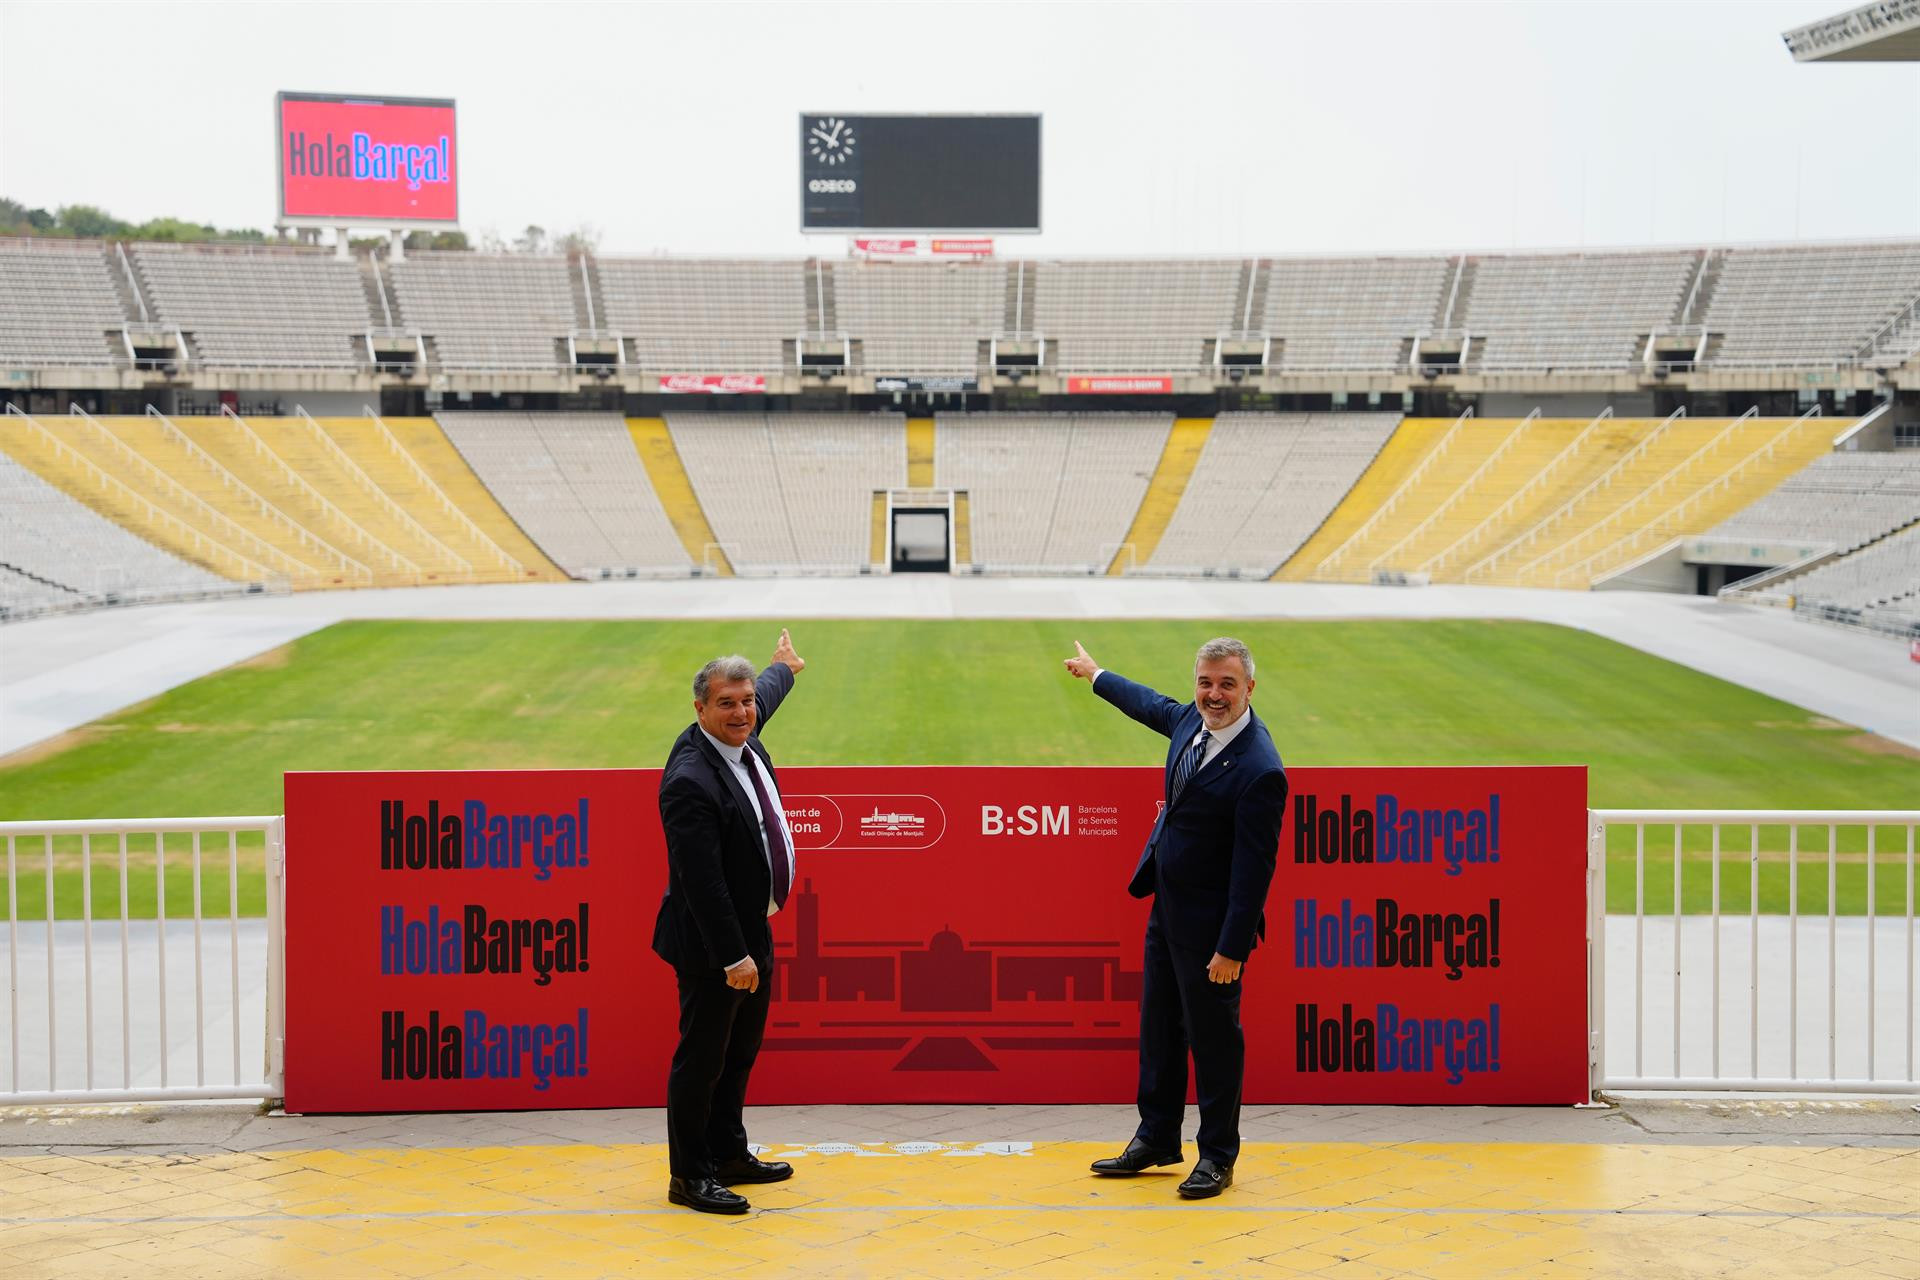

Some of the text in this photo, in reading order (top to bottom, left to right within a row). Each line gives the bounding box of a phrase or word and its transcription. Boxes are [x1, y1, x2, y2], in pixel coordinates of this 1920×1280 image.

[289, 130, 449, 190] HolaBarça!
[381, 798, 589, 881] HolaBarça!
[808, 808, 821, 818] de
[981, 805, 1070, 835] B:SM
[1078, 805, 1118, 814] Barcelona
[1078, 816, 1118, 825] de Serveis
[1078, 828, 1118, 837] Municipals
[1294, 794, 1500, 876] HolaBarça!
[381, 903, 589, 986] HolaBarça!
[1295, 898, 1500, 981] HolaBarça!
[382, 1008, 589, 1091] HolaBarça!
[1296, 1003, 1500, 1086] HolaBarça!
